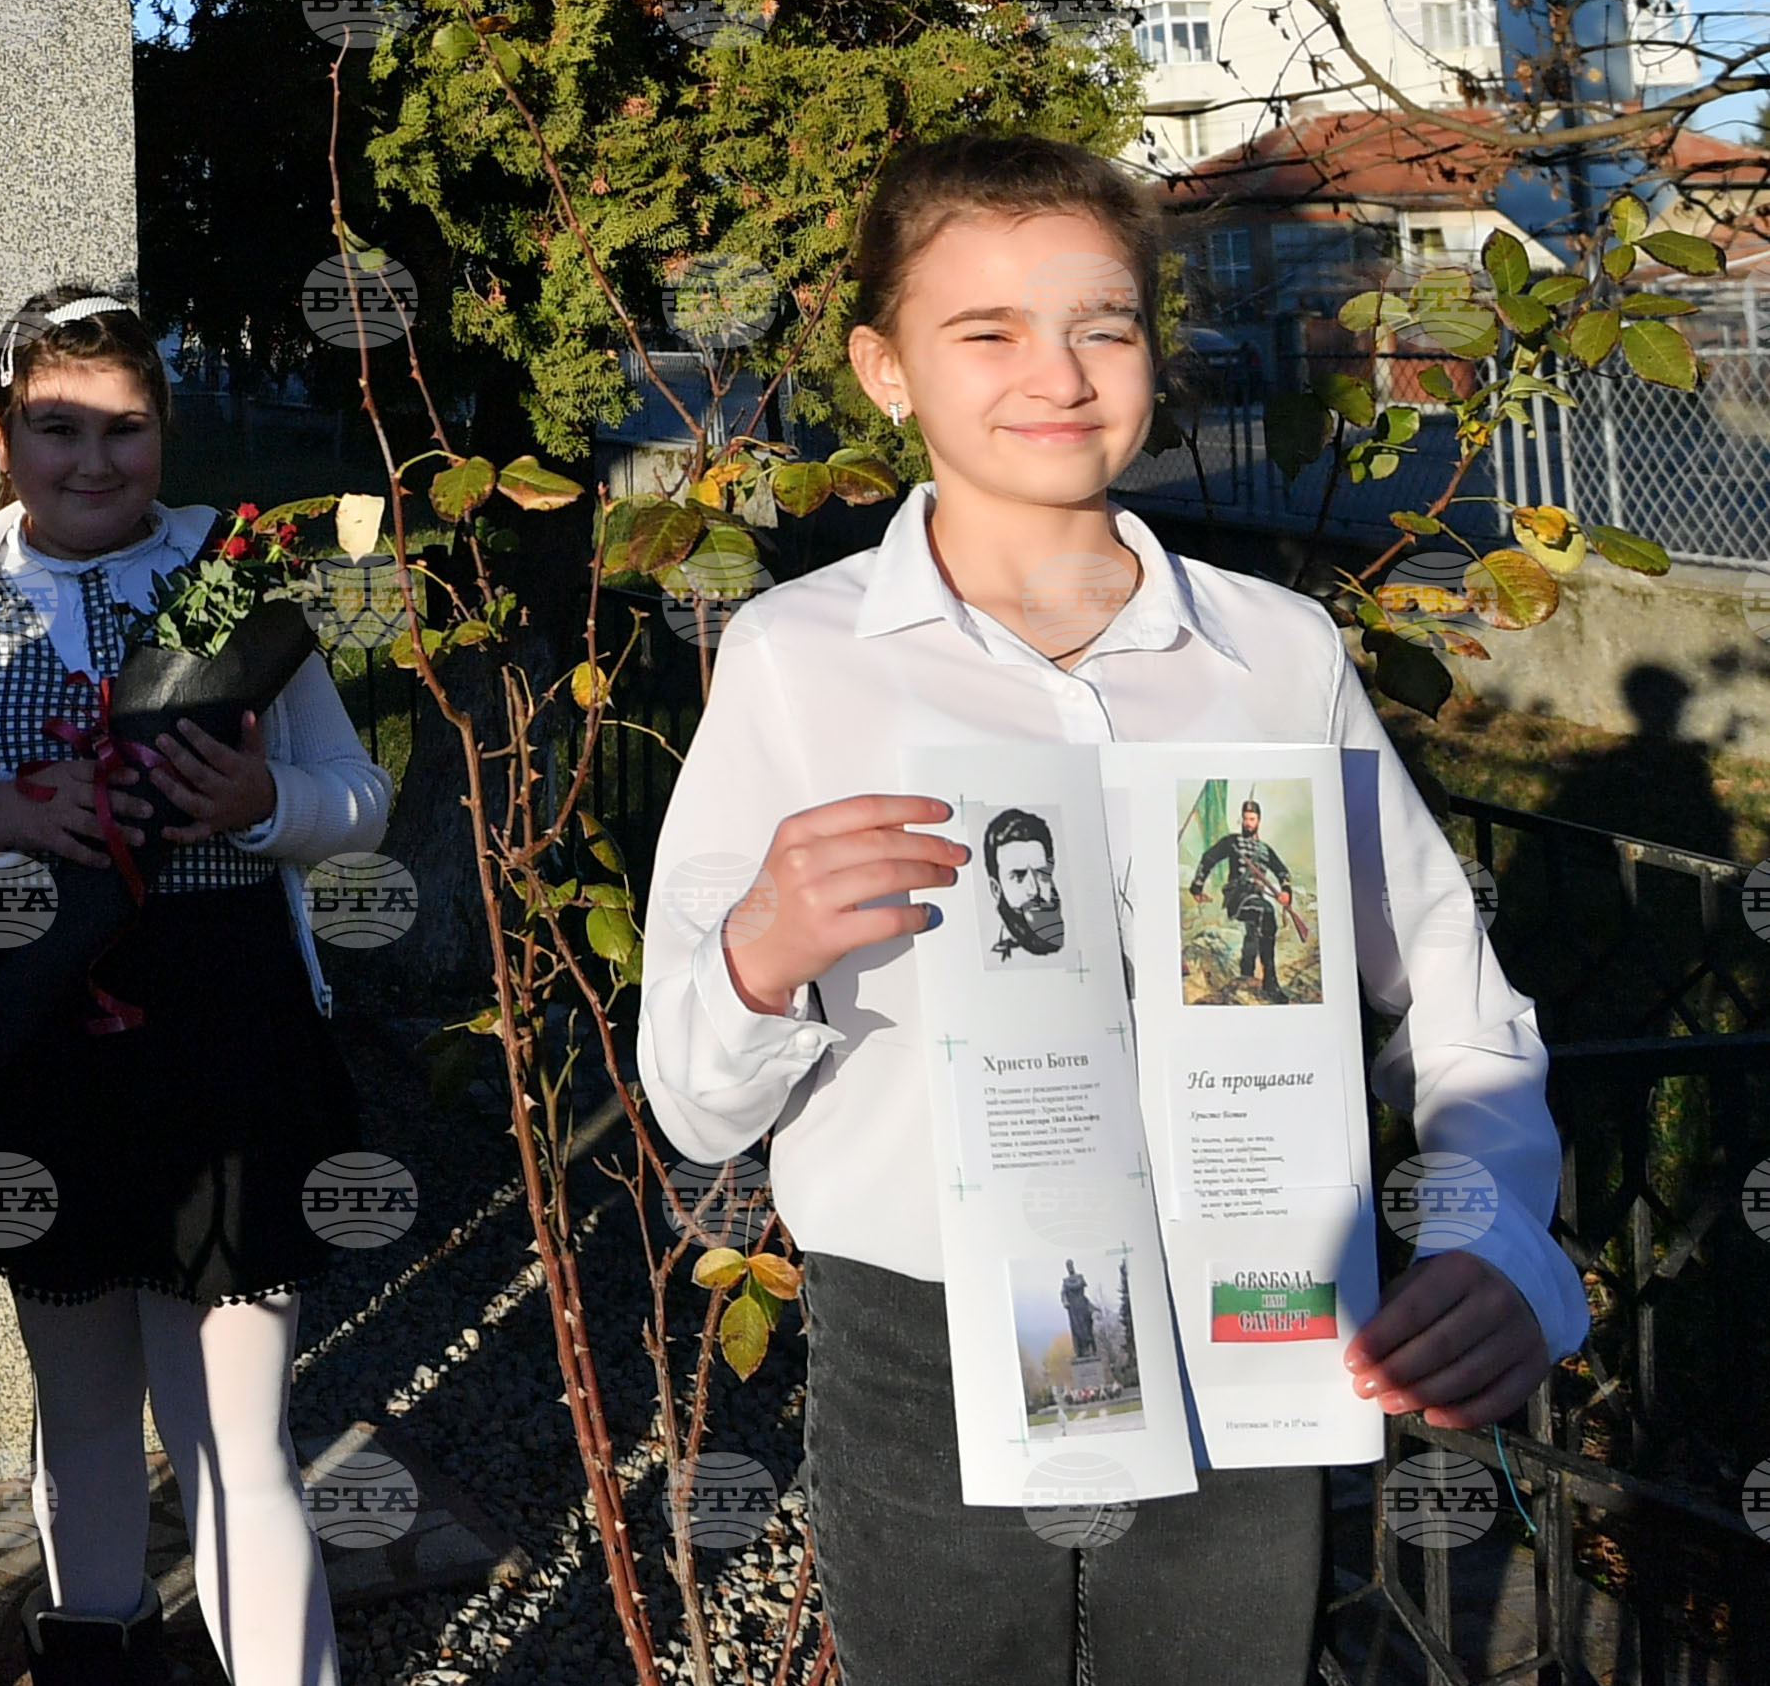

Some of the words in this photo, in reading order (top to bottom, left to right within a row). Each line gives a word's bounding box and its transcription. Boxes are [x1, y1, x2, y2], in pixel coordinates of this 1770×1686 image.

[983, 1055, 1043, 1075] Христо
[1046, 1052, 1090, 1069] Ботев
[1187, 1070, 1215, 1090] На
[1222, 1071, 1315, 1094] прощаване
[1235, 1270, 1316, 1293] СВОБОДА
